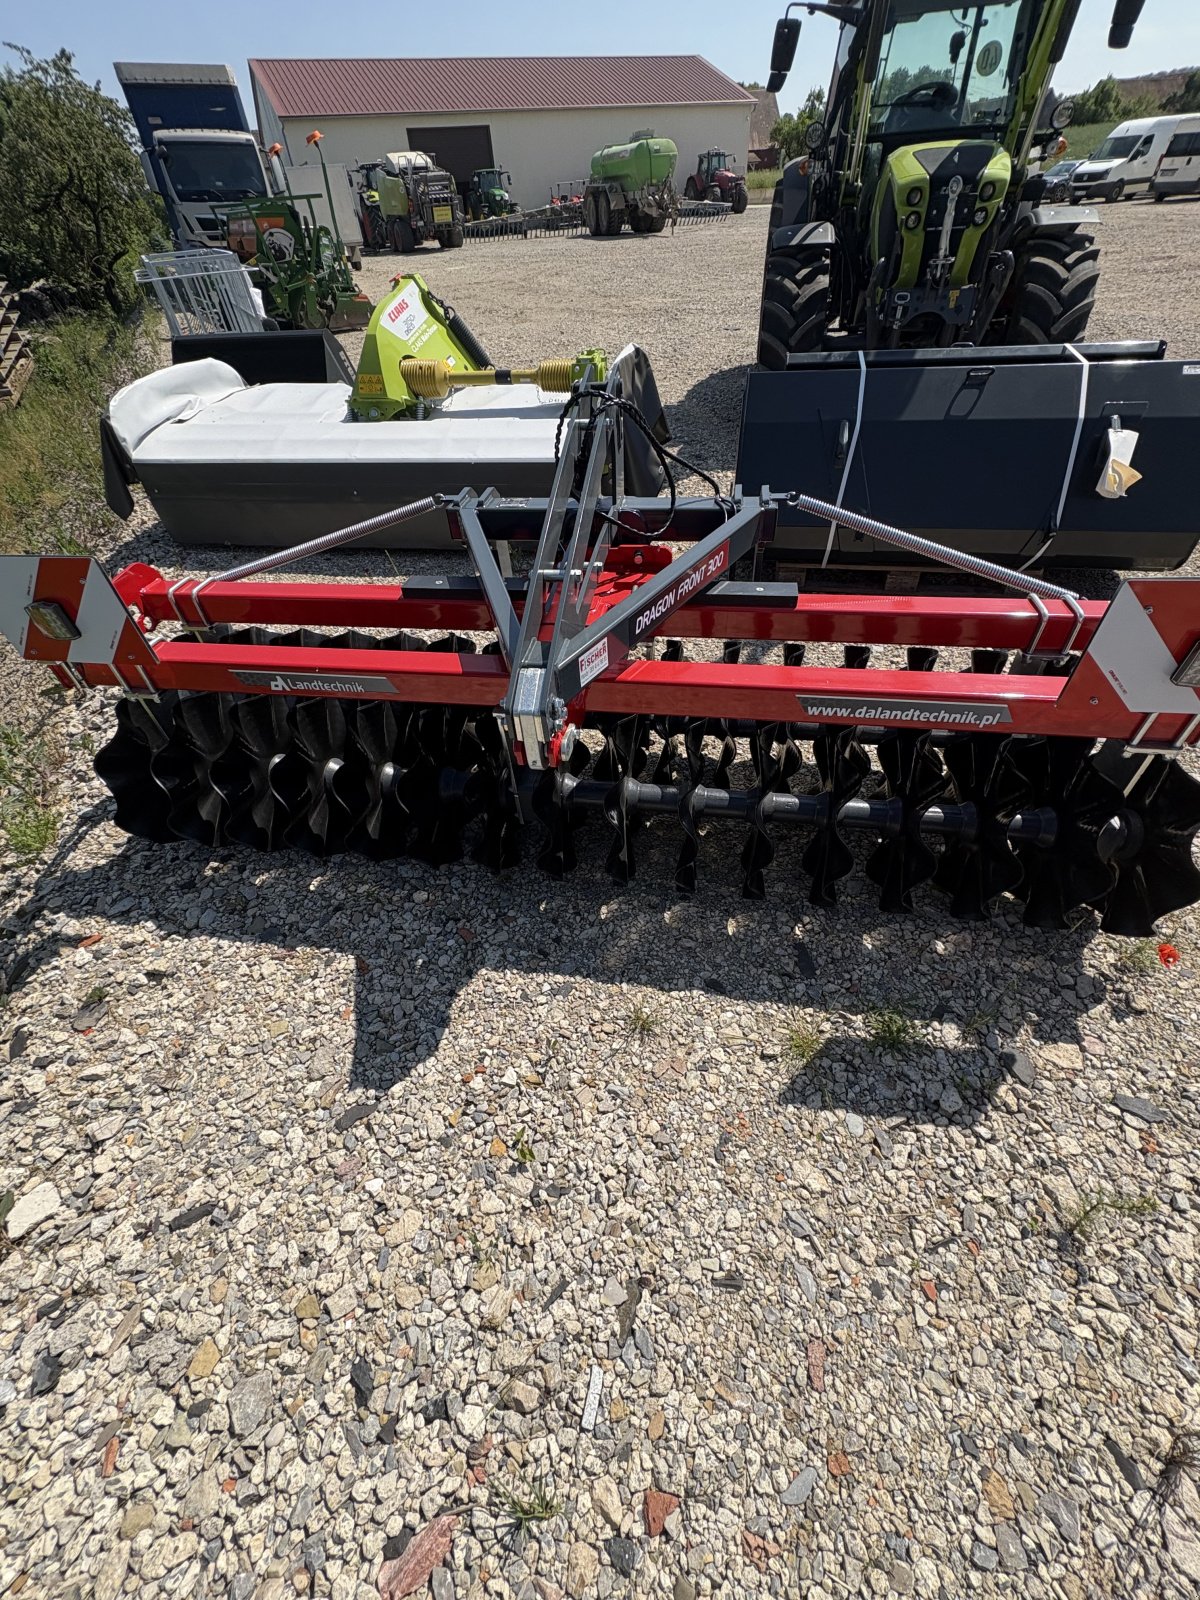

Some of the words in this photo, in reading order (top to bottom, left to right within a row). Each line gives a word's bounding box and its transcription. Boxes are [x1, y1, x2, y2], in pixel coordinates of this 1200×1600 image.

[387, 298, 409, 323] CLAAS
[636, 589, 675, 635] DRAGON
[677, 566, 706, 600] FRONT
[707, 551, 724, 575] 300
[288, 678, 364, 693] Landtechnik
[807, 705, 1000, 728] www.dalandtechnik.pl
